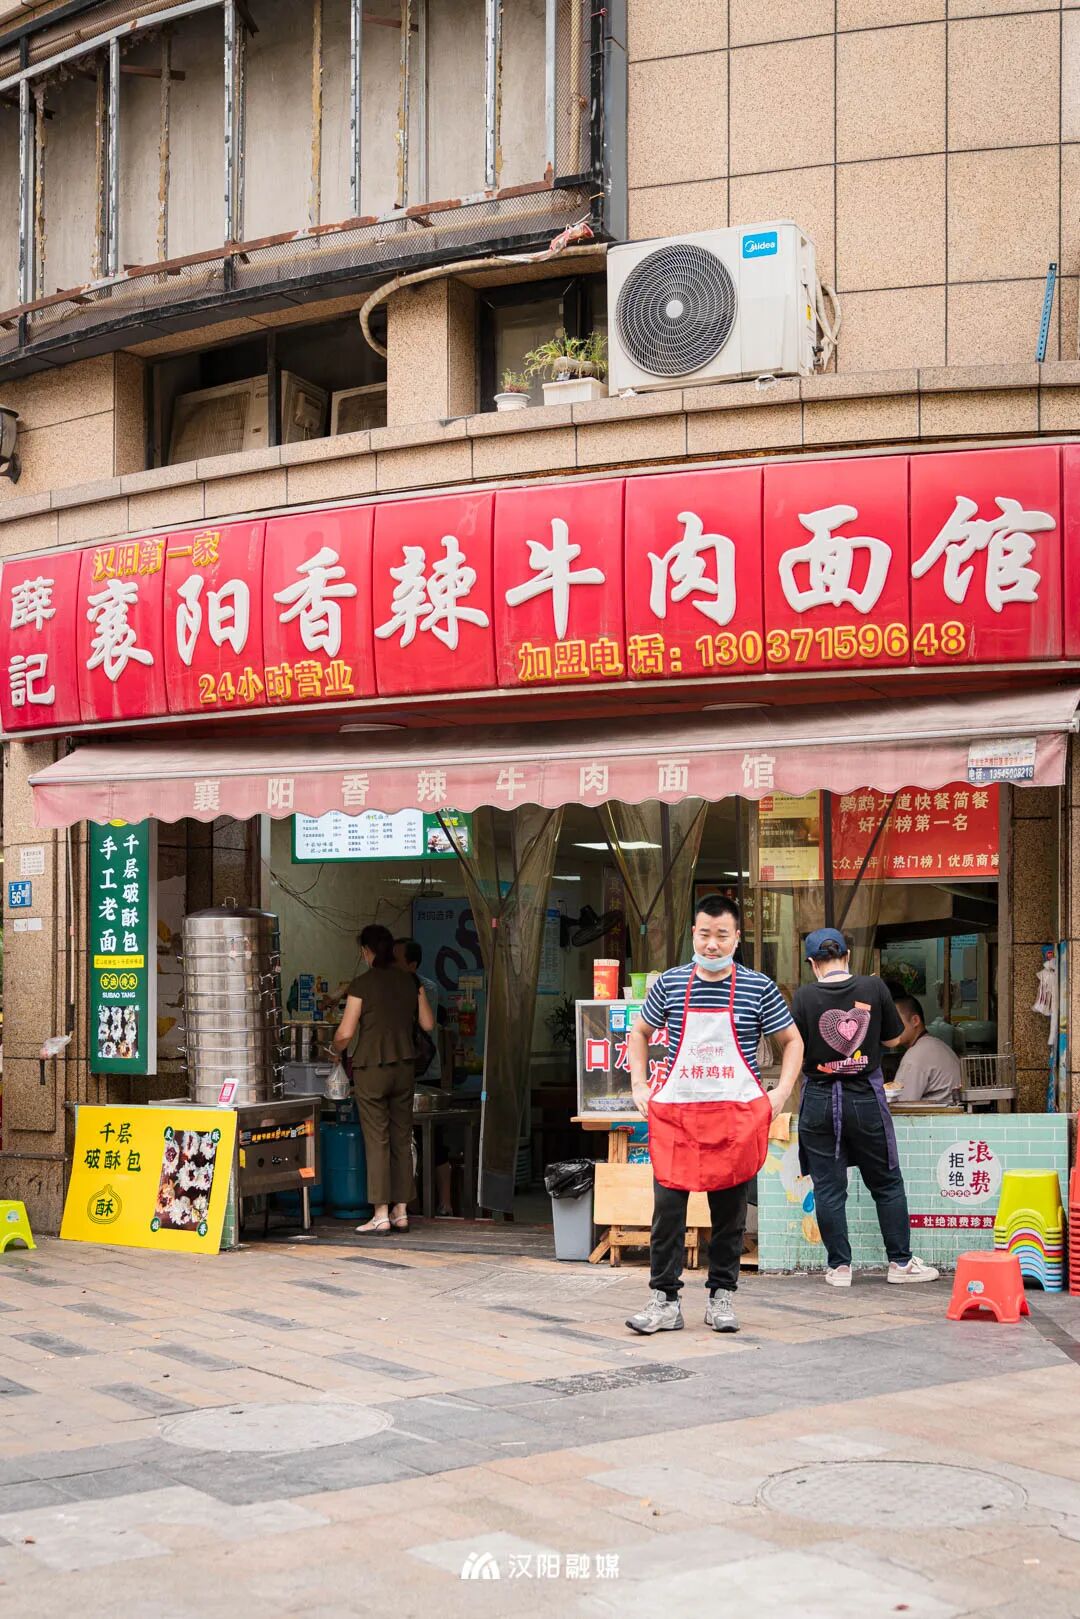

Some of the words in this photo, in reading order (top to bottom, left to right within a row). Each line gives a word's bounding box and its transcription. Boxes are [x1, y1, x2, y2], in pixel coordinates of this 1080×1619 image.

[745, 240, 776, 253] Midea
[92, 531, 221, 581] 汉阳第一家
[86, 495, 1057, 682] 襄阳香辣牛肉面馆
[198, 659, 355, 705] 24小时营业
[193, 753, 777, 812] 襄阳香辣牛肉面馆
[839, 791, 990, 813] 鹦鹉大道快餐简餐
[11, 891, 22, 904] 56
[98, 835, 119, 953] 手工老面
[121, 833, 140, 953] 千层破酥包
[679, 1065, 735, 1079] 大桥鸡精
[100, 1122, 133, 1145] 千层
[84, 1148, 142, 1172] 破酥包
[949, 1152, 965, 1187] 拒绝
[968, 1140, 993, 1195] 浪费
[95, 1198, 114, 1217] 酥
